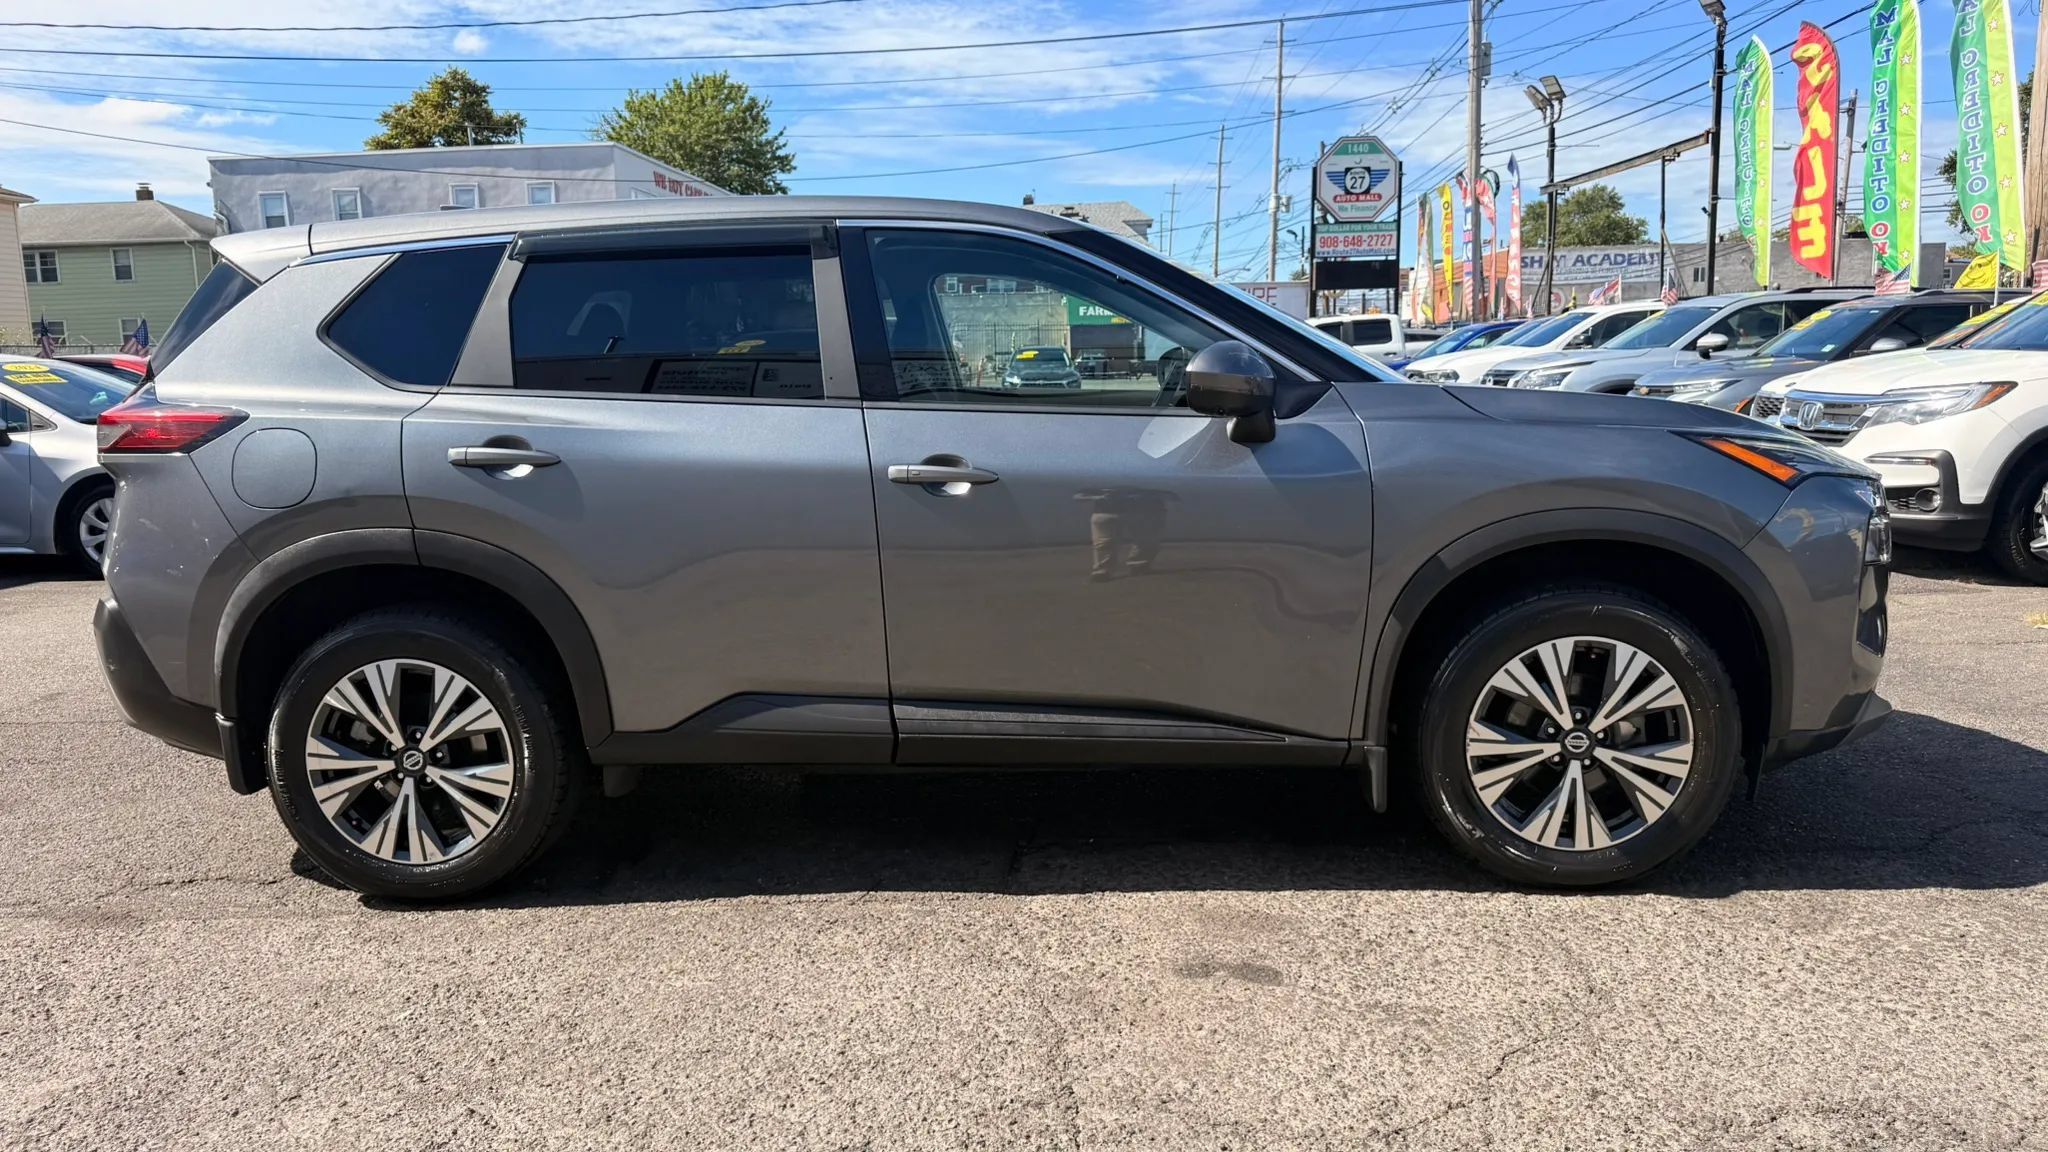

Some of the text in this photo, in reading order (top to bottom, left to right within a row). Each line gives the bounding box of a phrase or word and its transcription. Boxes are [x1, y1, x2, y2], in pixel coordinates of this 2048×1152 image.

[1347, 143, 1369, 153] 1440
[1350, 176, 1366, 190] 27
[1358, 193, 1379, 201] MALL
[1319, 234, 1393, 248] 908-648-2727
